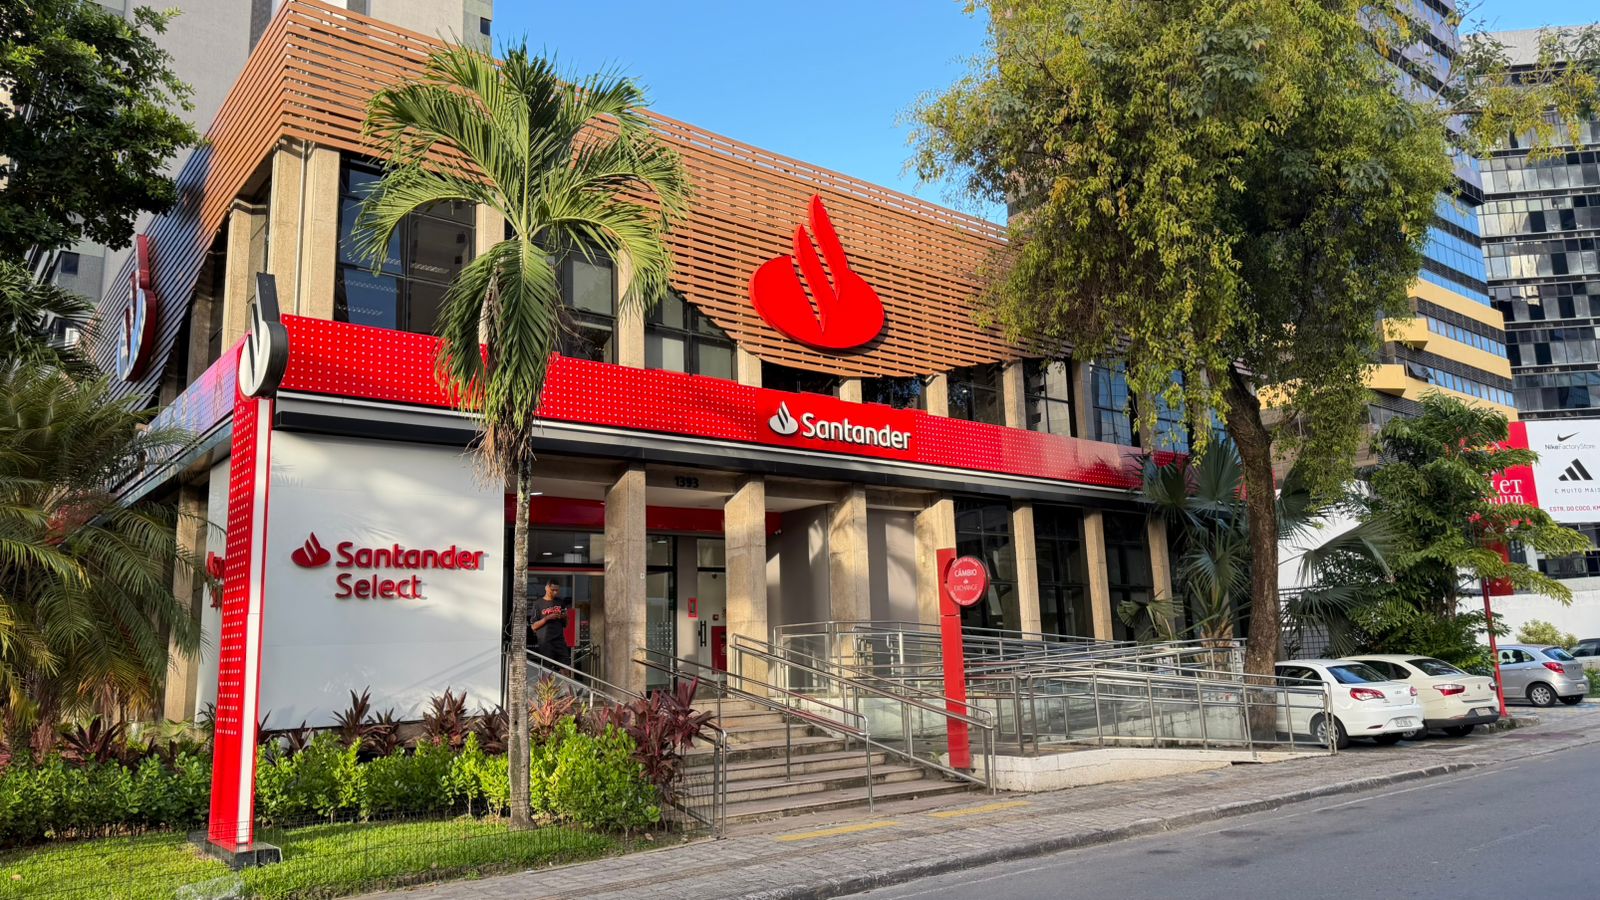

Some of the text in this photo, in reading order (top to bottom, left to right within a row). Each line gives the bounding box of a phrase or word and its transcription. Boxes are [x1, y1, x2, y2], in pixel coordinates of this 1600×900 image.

[801, 412, 912, 449] Santander
[674, 475, 700, 488] 1393
[335, 541, 484, 570] Santander
[954, 568, 977, 577] CÂMBIO
[335, 573, 423, 600] Select
